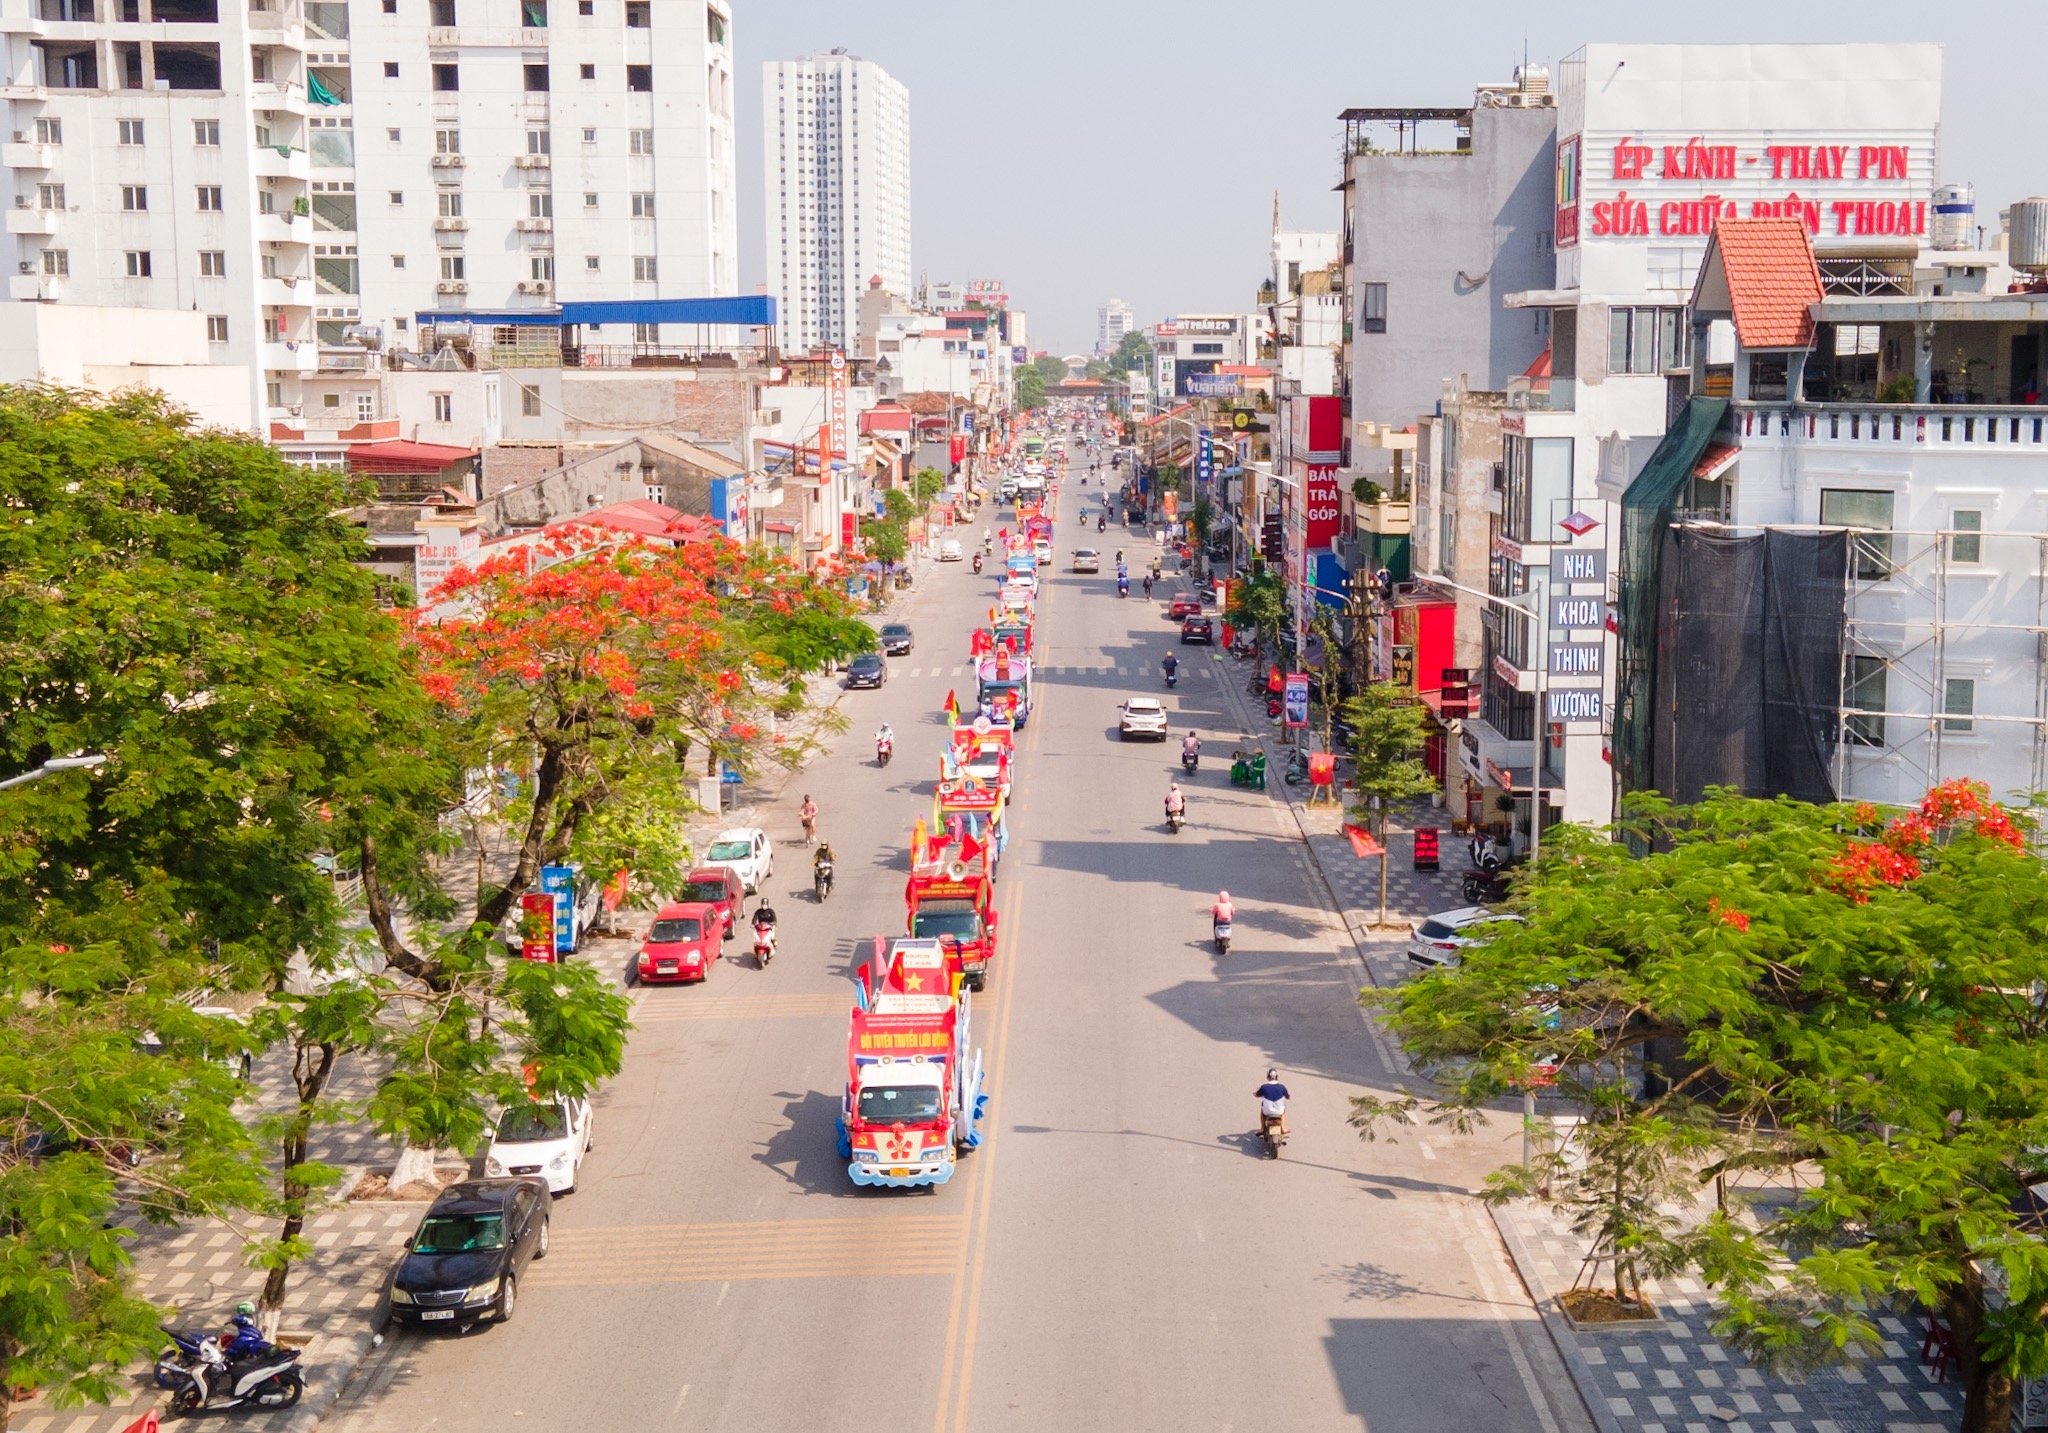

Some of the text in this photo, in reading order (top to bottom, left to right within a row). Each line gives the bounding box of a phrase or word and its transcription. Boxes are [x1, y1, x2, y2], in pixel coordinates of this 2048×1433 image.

[1613, 136, 1653, 180] ÉP
[1662, 136, 1737, 180] KÍNH
[1767, 145, 1849, 180] THAY
[1858, 145, 1910, 180] PIN
[1591, 190, 1650, 236] SỬA
[1308, 466, 1338, 482] BÁN
[1308, 484, 1338, 501] TRẢ
[1308, 505, 1338, 521] GÓP
[1563, 554, 1595, 578] NHA
[1558, 601, 1599, 625] KHOA
[1553, 648, 1599, 676] THỊNH
[1550, 691, 1600, 721] VƯỢNG
